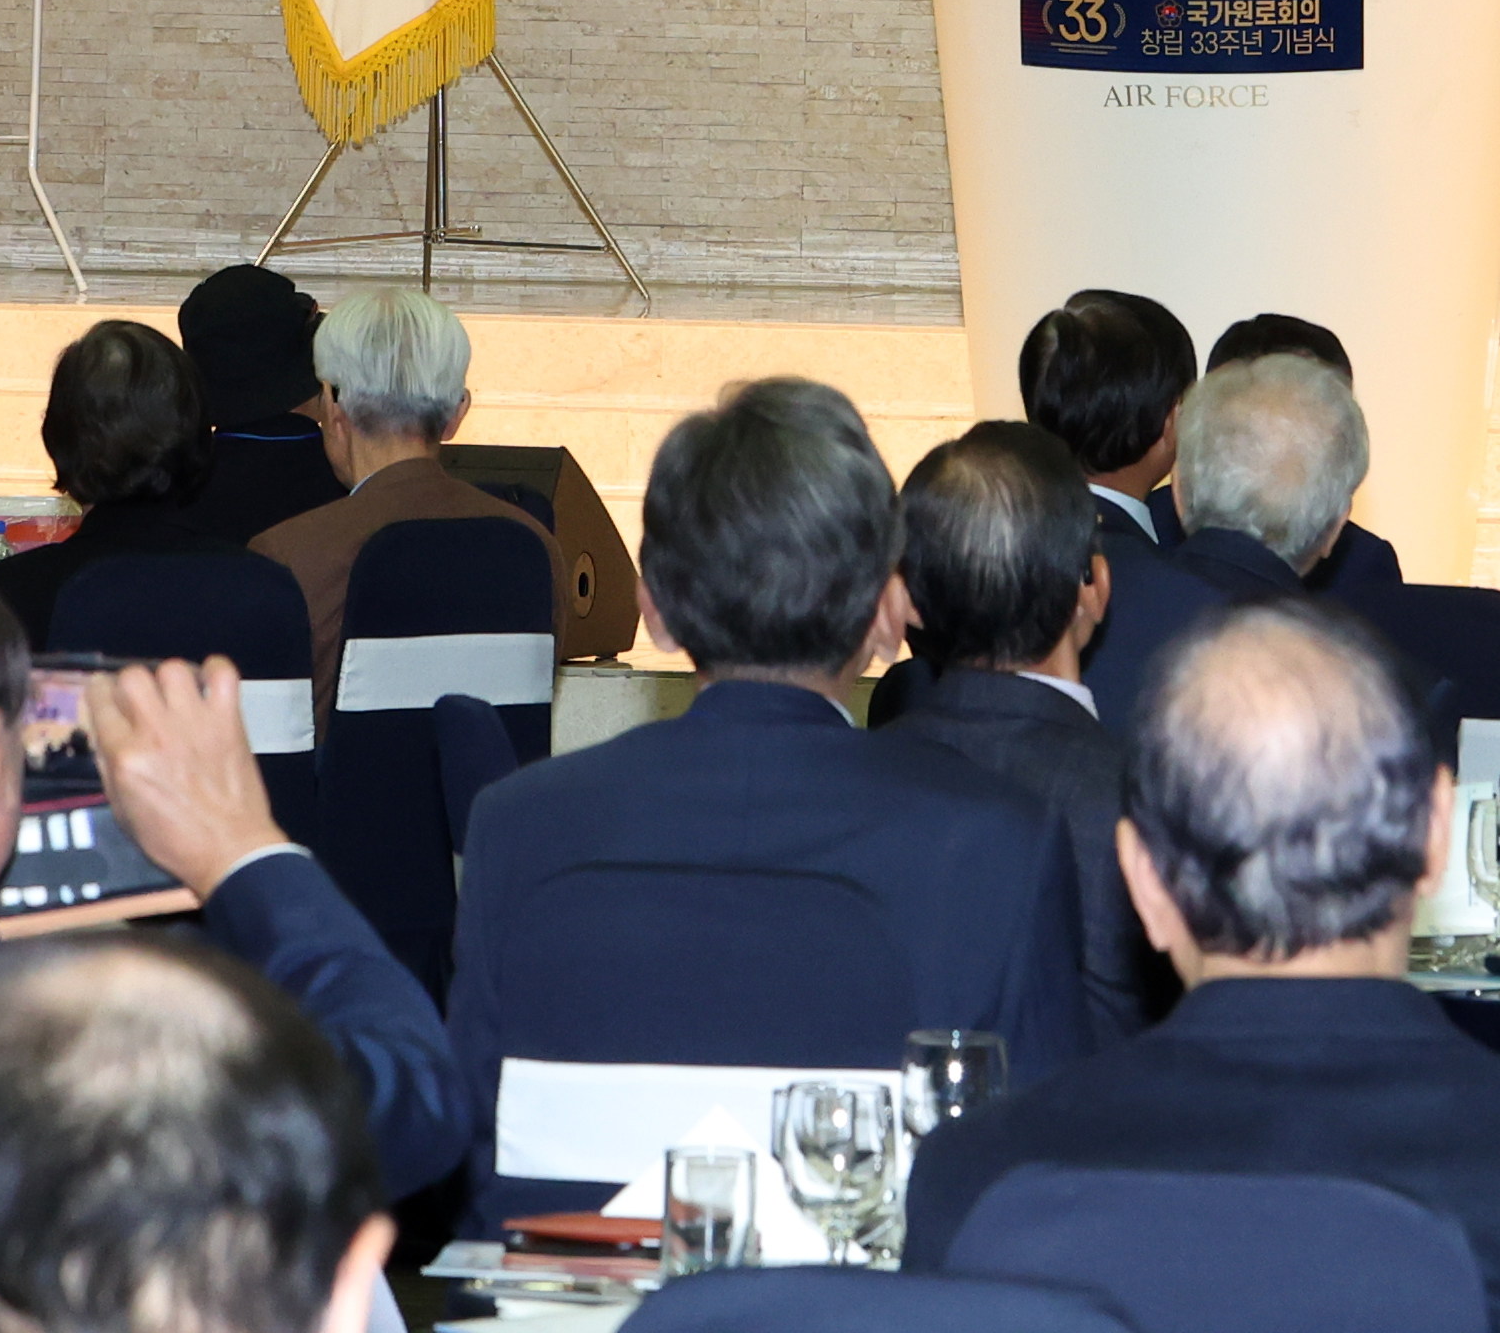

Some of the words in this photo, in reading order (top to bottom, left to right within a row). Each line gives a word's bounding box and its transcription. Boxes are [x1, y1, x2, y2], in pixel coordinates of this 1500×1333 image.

[1140, 28, 1183, 55] 창립
[1190, 29, 1263, 56] 33주년
[1270, 27, 1335, 55] 기념식
[1103, 84, 1156, 108] AIR
[1164, 83, 1270, 108] FORCE
